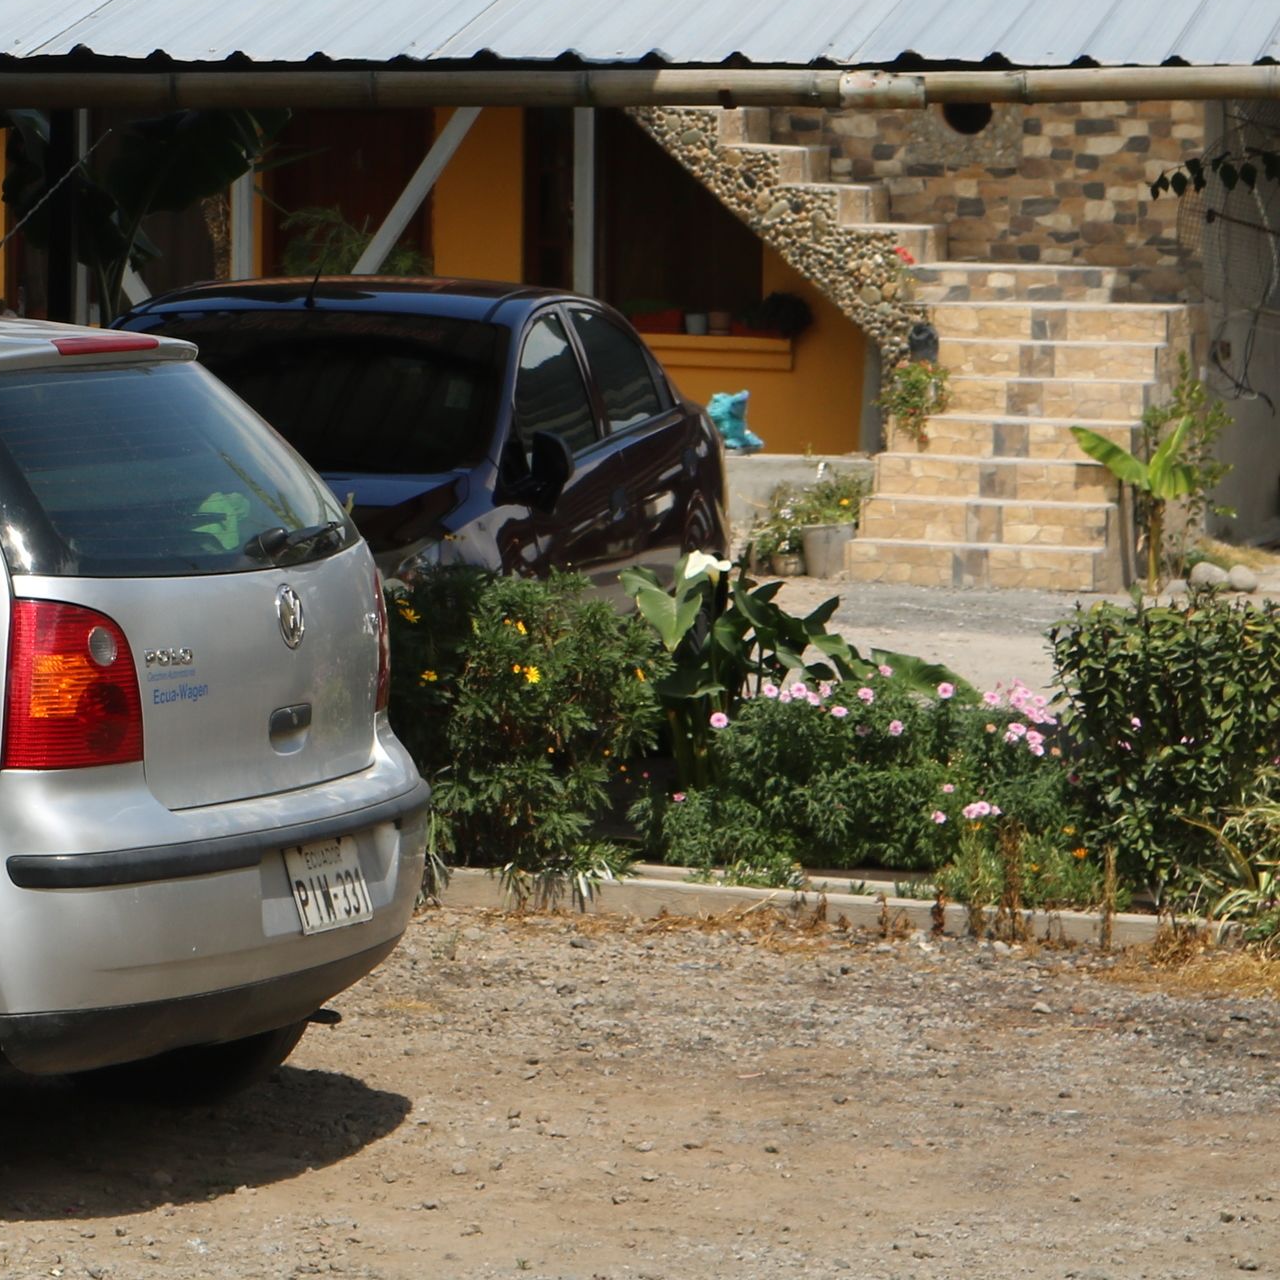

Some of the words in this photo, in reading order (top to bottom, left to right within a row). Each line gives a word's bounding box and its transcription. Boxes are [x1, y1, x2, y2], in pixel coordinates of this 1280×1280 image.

[144, 647, 193, 668] POLO
[153, 683, 209, 705] Ecua-Wagen
[304, 845, 343, 870] ECUADOR
